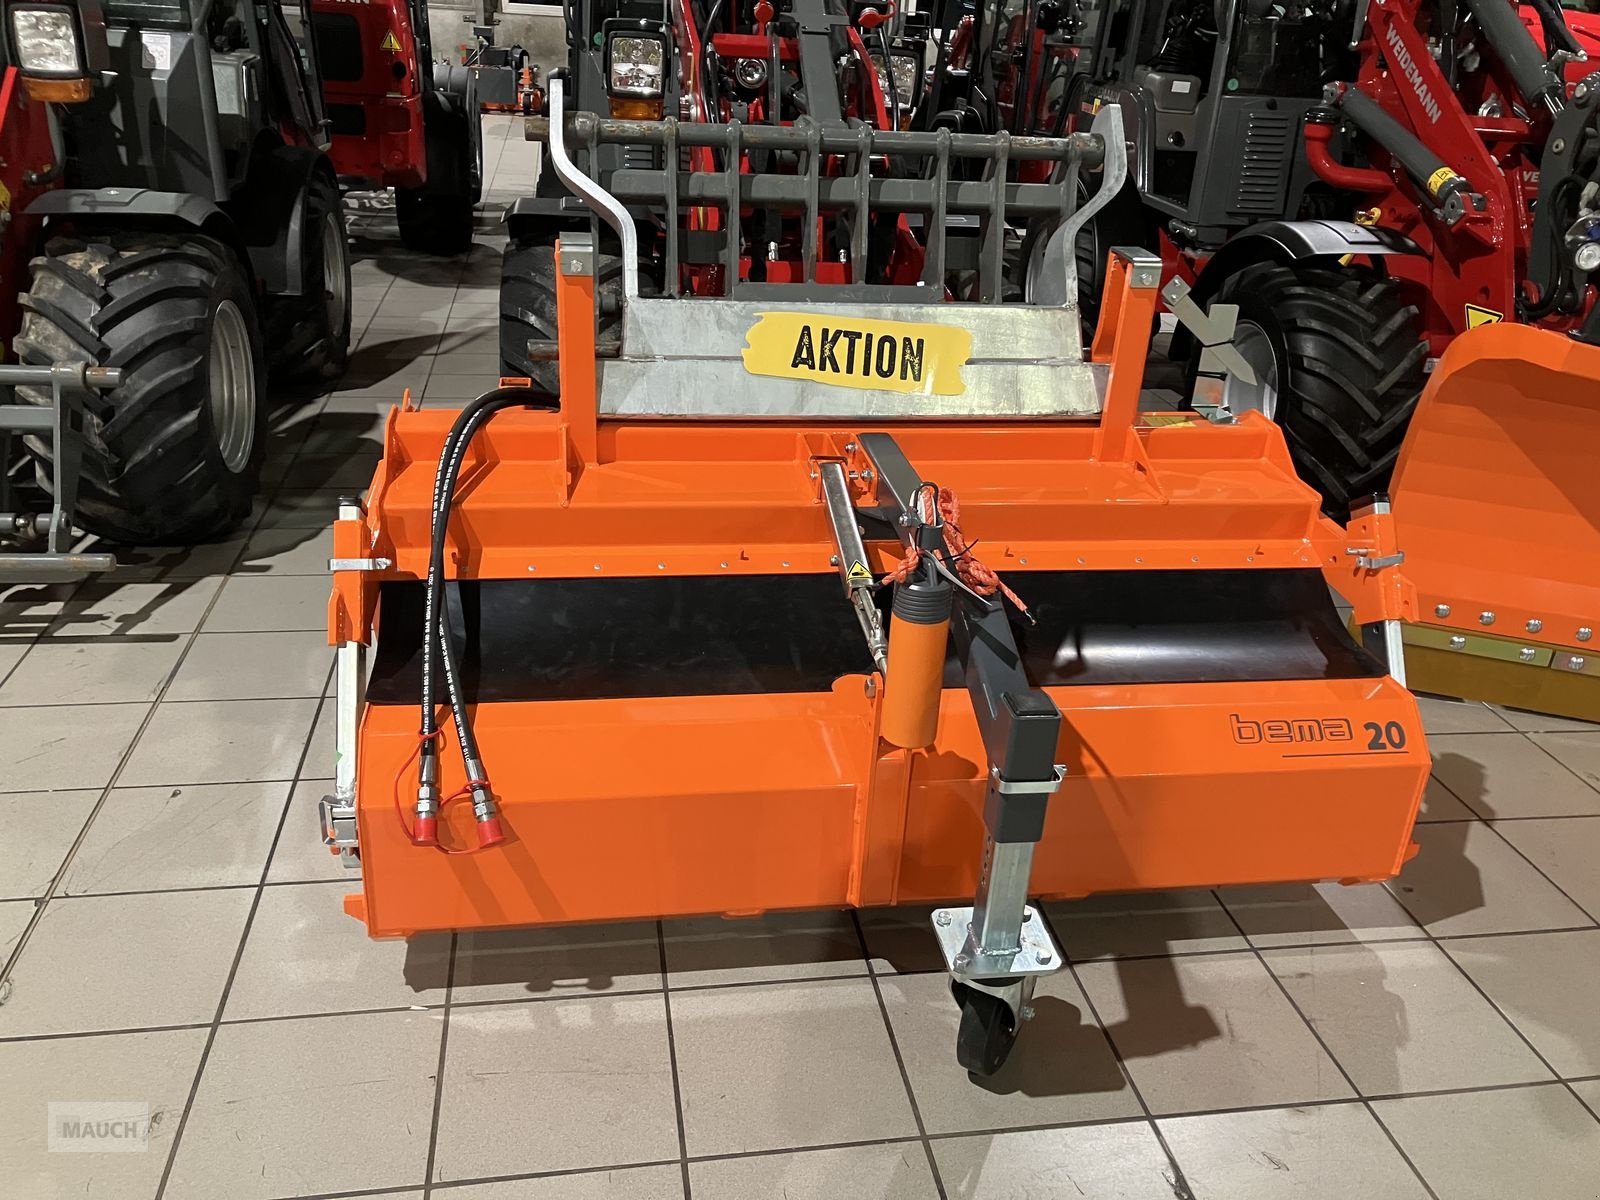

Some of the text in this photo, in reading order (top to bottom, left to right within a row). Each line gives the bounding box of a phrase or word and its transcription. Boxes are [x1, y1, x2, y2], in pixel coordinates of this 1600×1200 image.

[1386, 22, 1442, 124] WEIDEMANN
[791, 325, 925, 382] AKTION
[1230, 714, 1406, 750] bema 20
